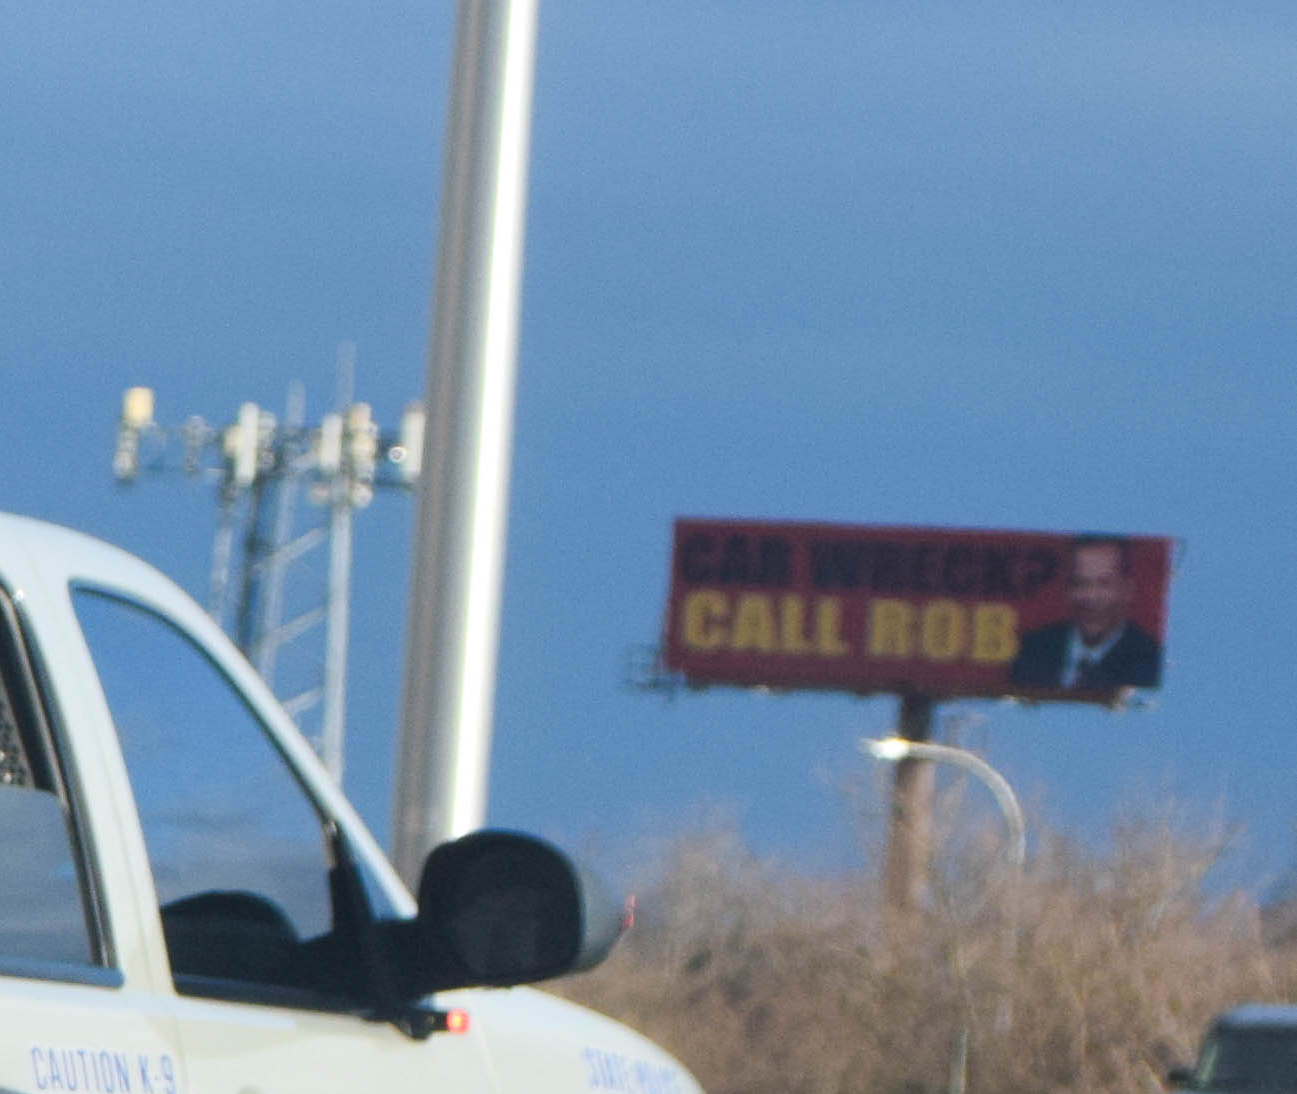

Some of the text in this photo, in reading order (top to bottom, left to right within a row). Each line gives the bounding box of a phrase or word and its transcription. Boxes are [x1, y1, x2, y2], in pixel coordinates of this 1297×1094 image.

[682, 592, 1021, 664] CALL ROB
[31, 1046, 132, 1094] CAUTION
